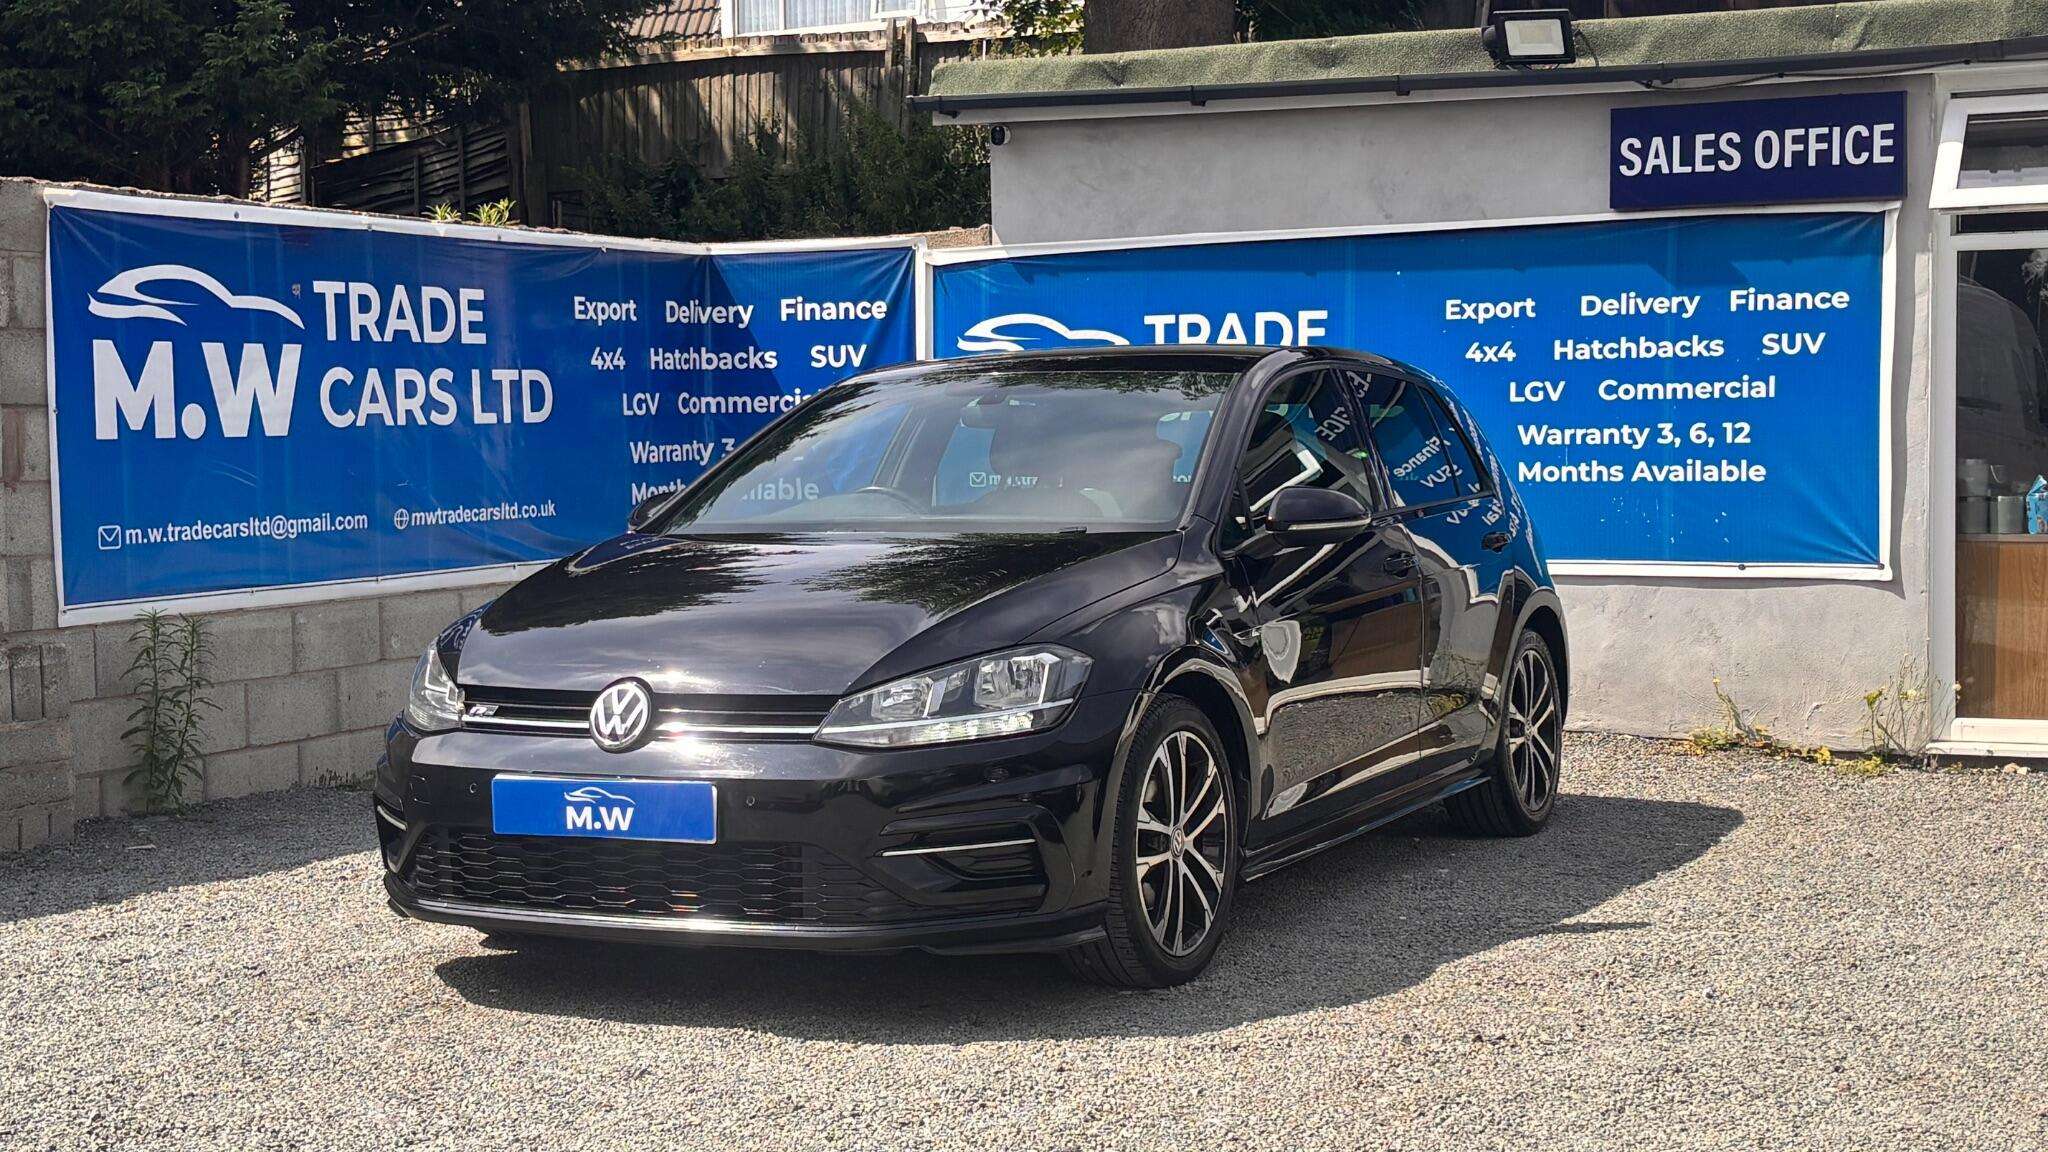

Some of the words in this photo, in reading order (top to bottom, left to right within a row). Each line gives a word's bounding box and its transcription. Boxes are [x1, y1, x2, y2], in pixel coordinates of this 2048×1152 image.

[1619, 131, 1742, 177] SALES
[1754, 123, 1895, 170] OFFICE
[312, 280, 487, 345] TRADE
[573, 295, 638, 326] Export
[665, 299, 754, 329] Delivery
[780, 295, 888, 322] Finance
[1445, 297, 1537, 325] Export
[1580, 291, 1701, 319] Delivery
[1730, 287, 1850, 312] Finance
[1144, 310, 1329, 347] TRADE
[590, 346, 626, 370] 4x4
[650, 345, 778, 370] Hatchbacks
[810, 343, 867, 368] SUV
[1465, 341, 1517, 363] 4x4
[1553, 334, 1725, 361] Hatchbacks
[1762, 332, 1826, 356] SUV
[92, 339, 303, 440] M.W
[319, 366, 458, 428] CARS
[471, 368, 553, 425] LTD
[622, 392, 660, 416] LGV
[677, 387, 822, 414] Commerci
[1509, 380, 1566, 403] LGV
[1598, 374, 1776, 401] Commercial
[1517, 424, 1651, 450] Warranty
[1656, 422, 1682, 448] 3,
[1689, 422, 1715, 448] 6,
[1722, 421, 1751, 444] 12
[629, 440, 714, 466] Warranty
[1517, 461, 1623, 483] Months
[1631, 459, 1767, 482] Available
[125, 512, 368, 545] m.w.tradecarsltd@gmail.com
[411, 499, 557, 527] mwtradecarsltd.co.uk
[566, 805, 634, 831] M.W
